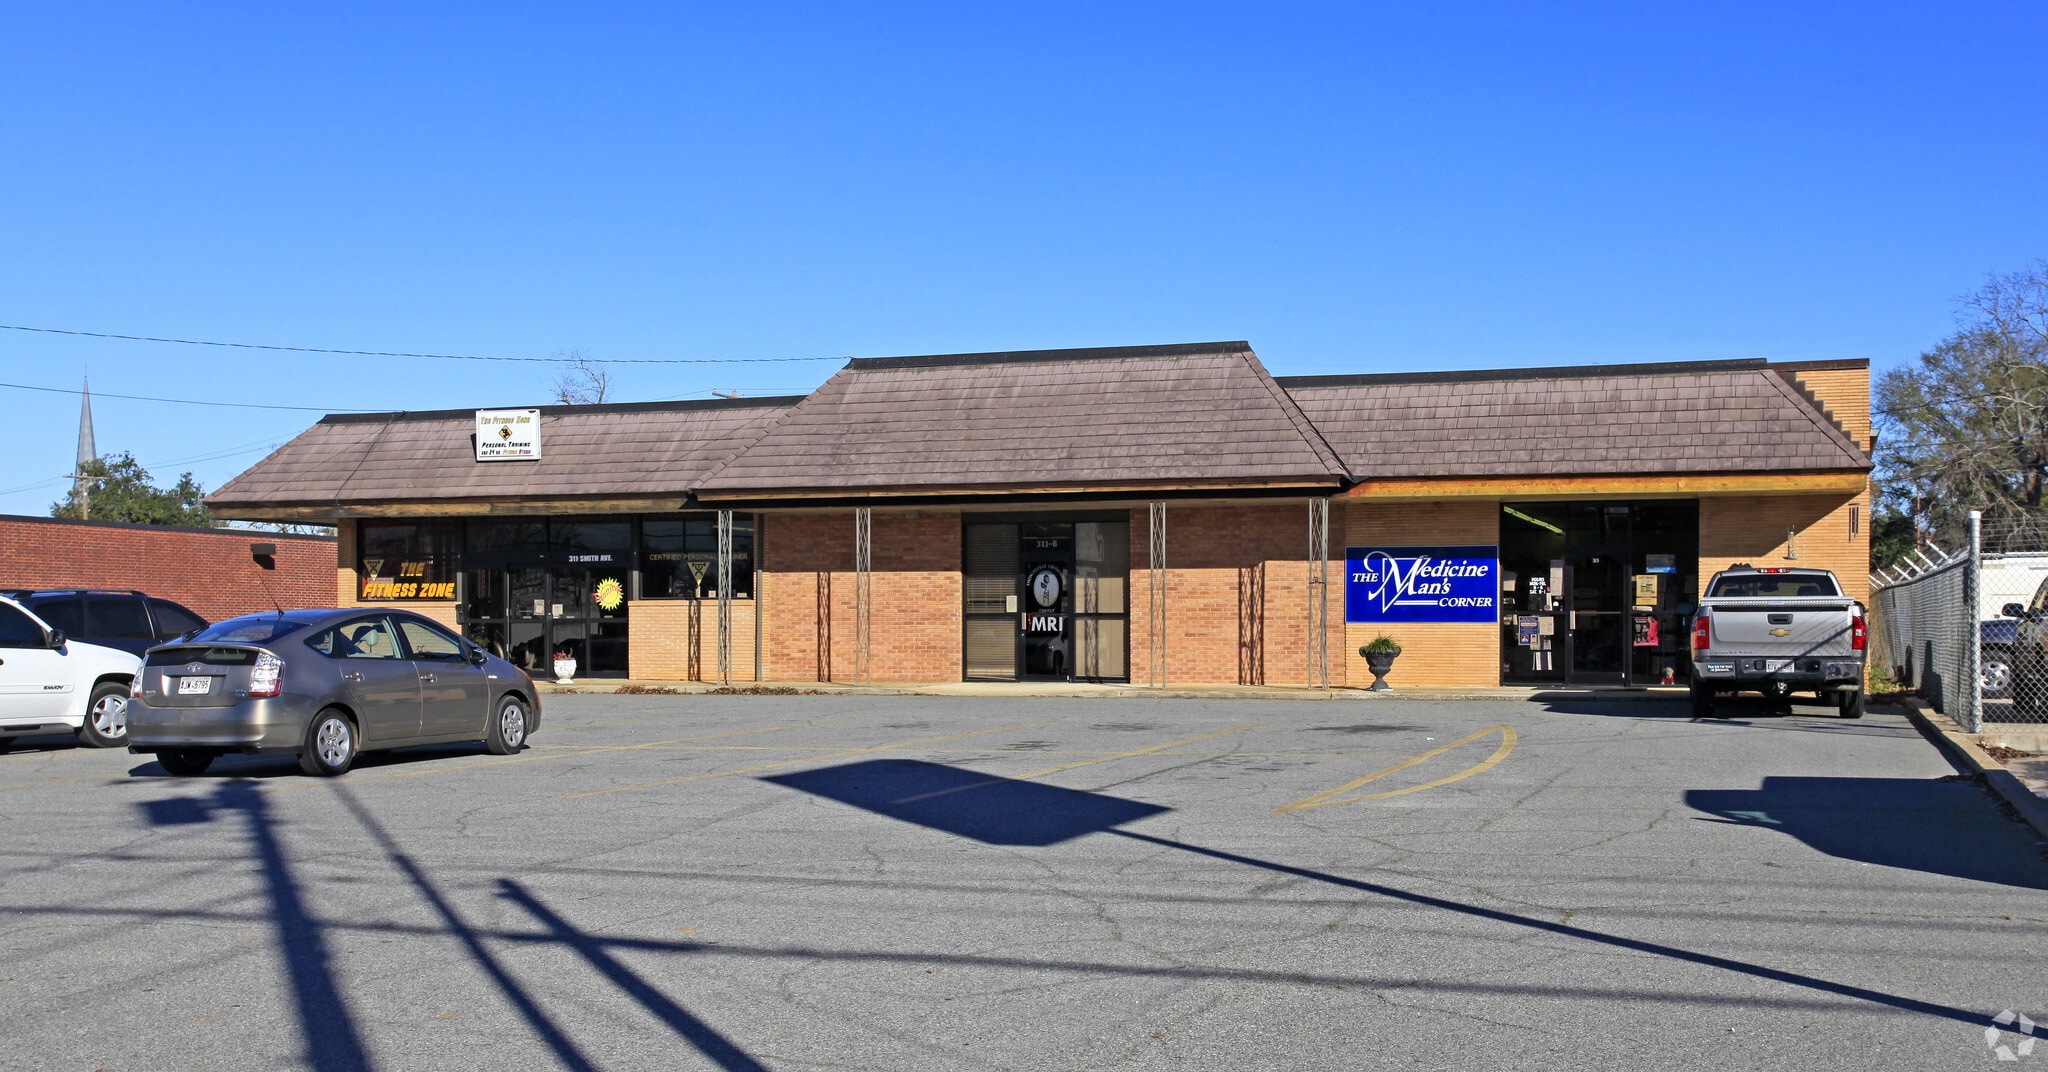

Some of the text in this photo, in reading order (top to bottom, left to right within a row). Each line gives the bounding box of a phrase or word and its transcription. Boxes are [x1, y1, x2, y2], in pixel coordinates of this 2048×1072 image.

[400, 562, 426, 577] THE
[1352, 572, 1379, 583] THE
[362, 582, 455, 598] FITNESS ZONE
[1439, 597, 1493, 607] CORNER
[1031, 616, 1063, 632] MRI
